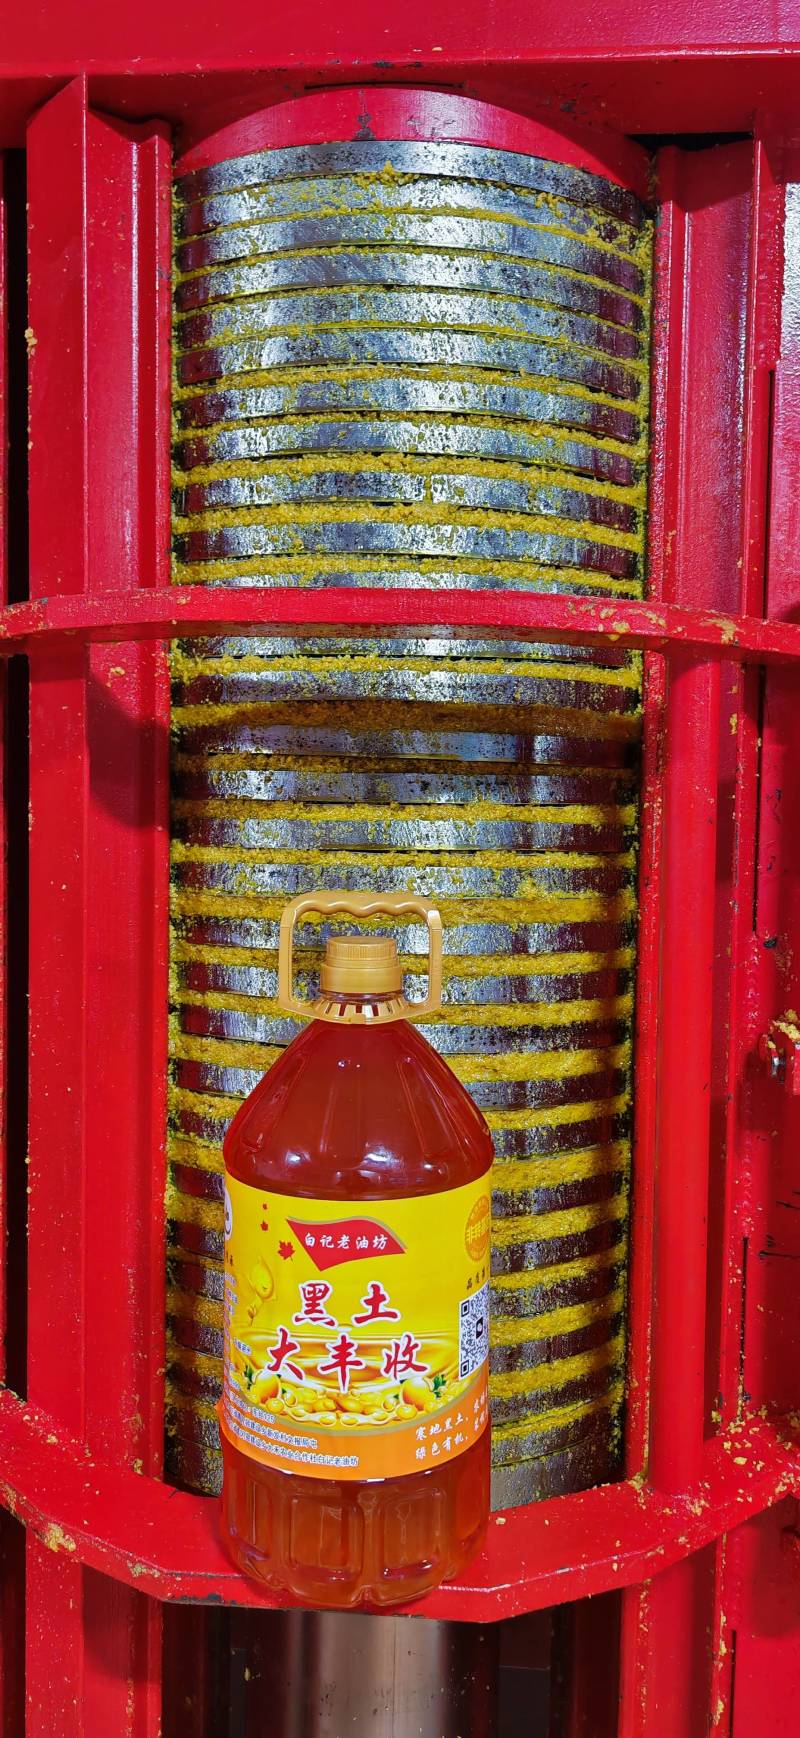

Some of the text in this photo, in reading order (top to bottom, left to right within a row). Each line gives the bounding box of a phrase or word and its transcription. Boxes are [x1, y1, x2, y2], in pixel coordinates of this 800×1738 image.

[305, 1232, 388, 1250] 白记老油坊
[294, 1281, 399, 1328] 黑土
[266, 1326, 428, 1392] 大丰收
